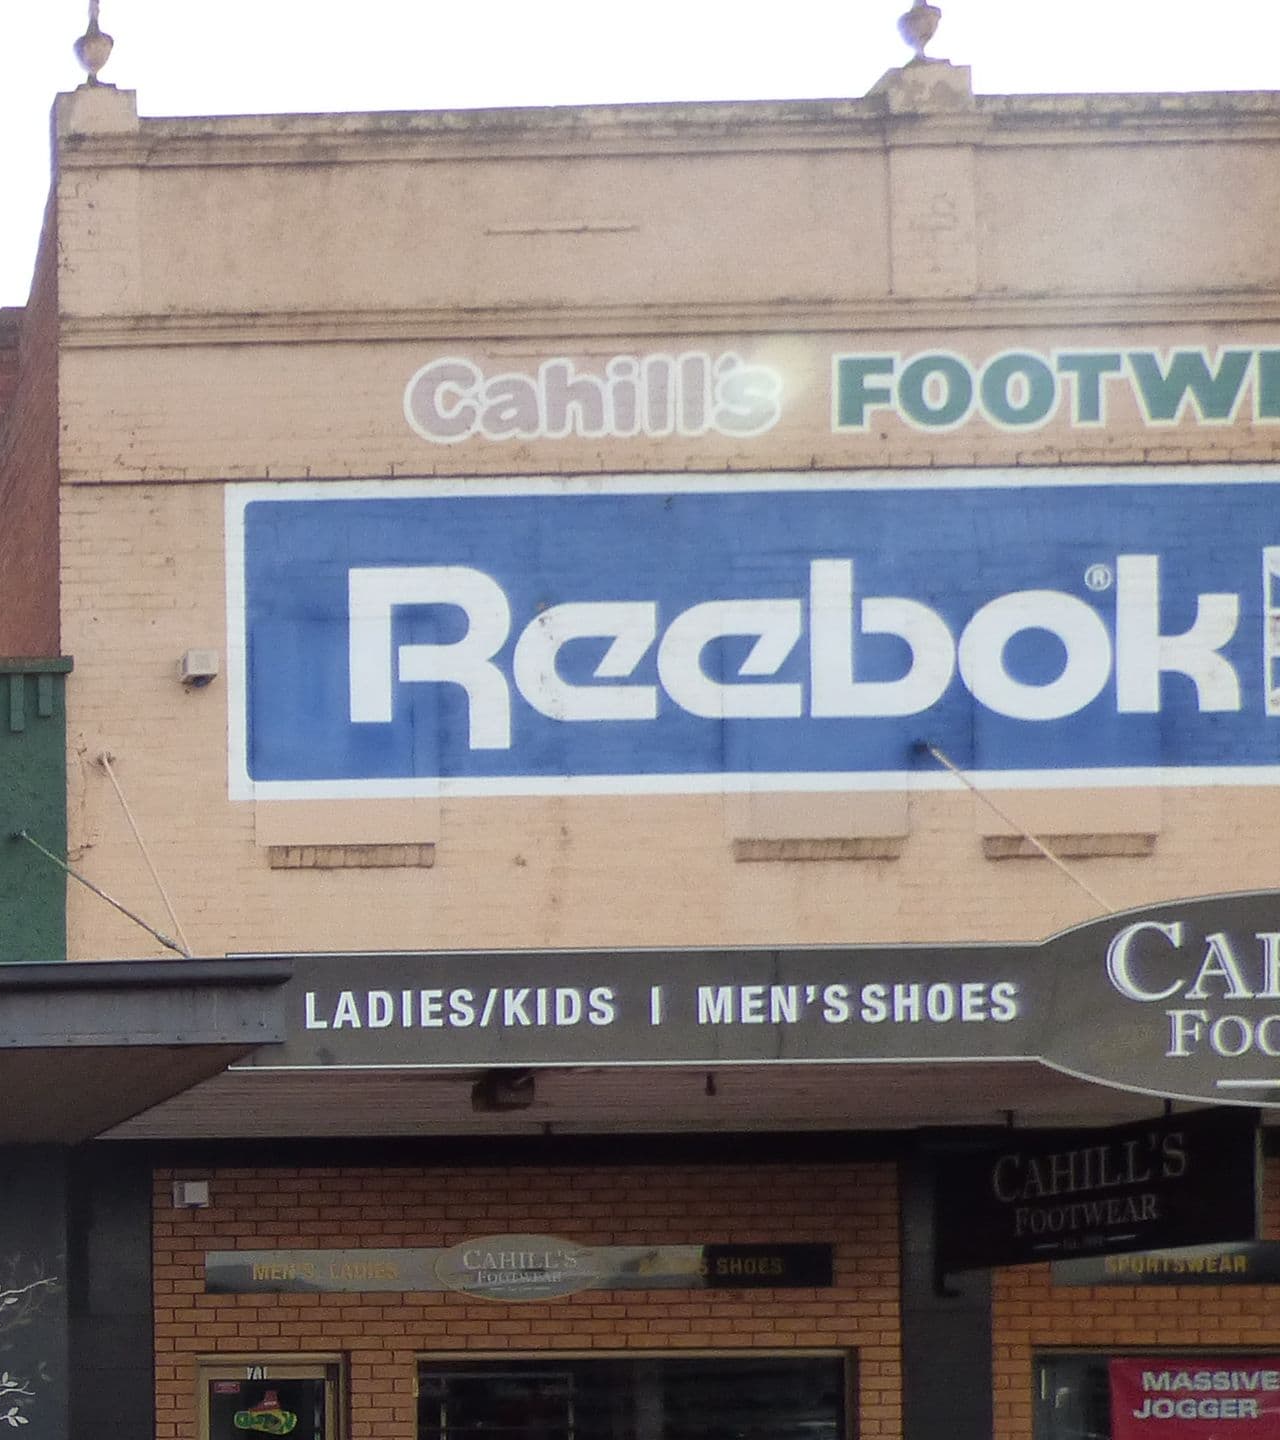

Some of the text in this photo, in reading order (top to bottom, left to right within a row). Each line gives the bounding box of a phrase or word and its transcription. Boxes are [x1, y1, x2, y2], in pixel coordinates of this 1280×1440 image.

[405, 352, 784, 440] Cahill's
[348, 555, 1239, 751] Reebok
[304, 986, 615, 1030] LADIES/KIDS
[992, 1131, 1188, 1203] CAHILL'S
[1013, 1193, 1158, 1238] FOOTWEAR
[463, 1248, 577, 1270] CAHILL'S
[716, 1256, 784, 1275] SHOES
[1104, 1255, 1248, 1273] SPORTSWEAR
[1141, 1371, 1280, 1391] MASSIVE
[1133, 1397, 1259, 1419] JOGGER
